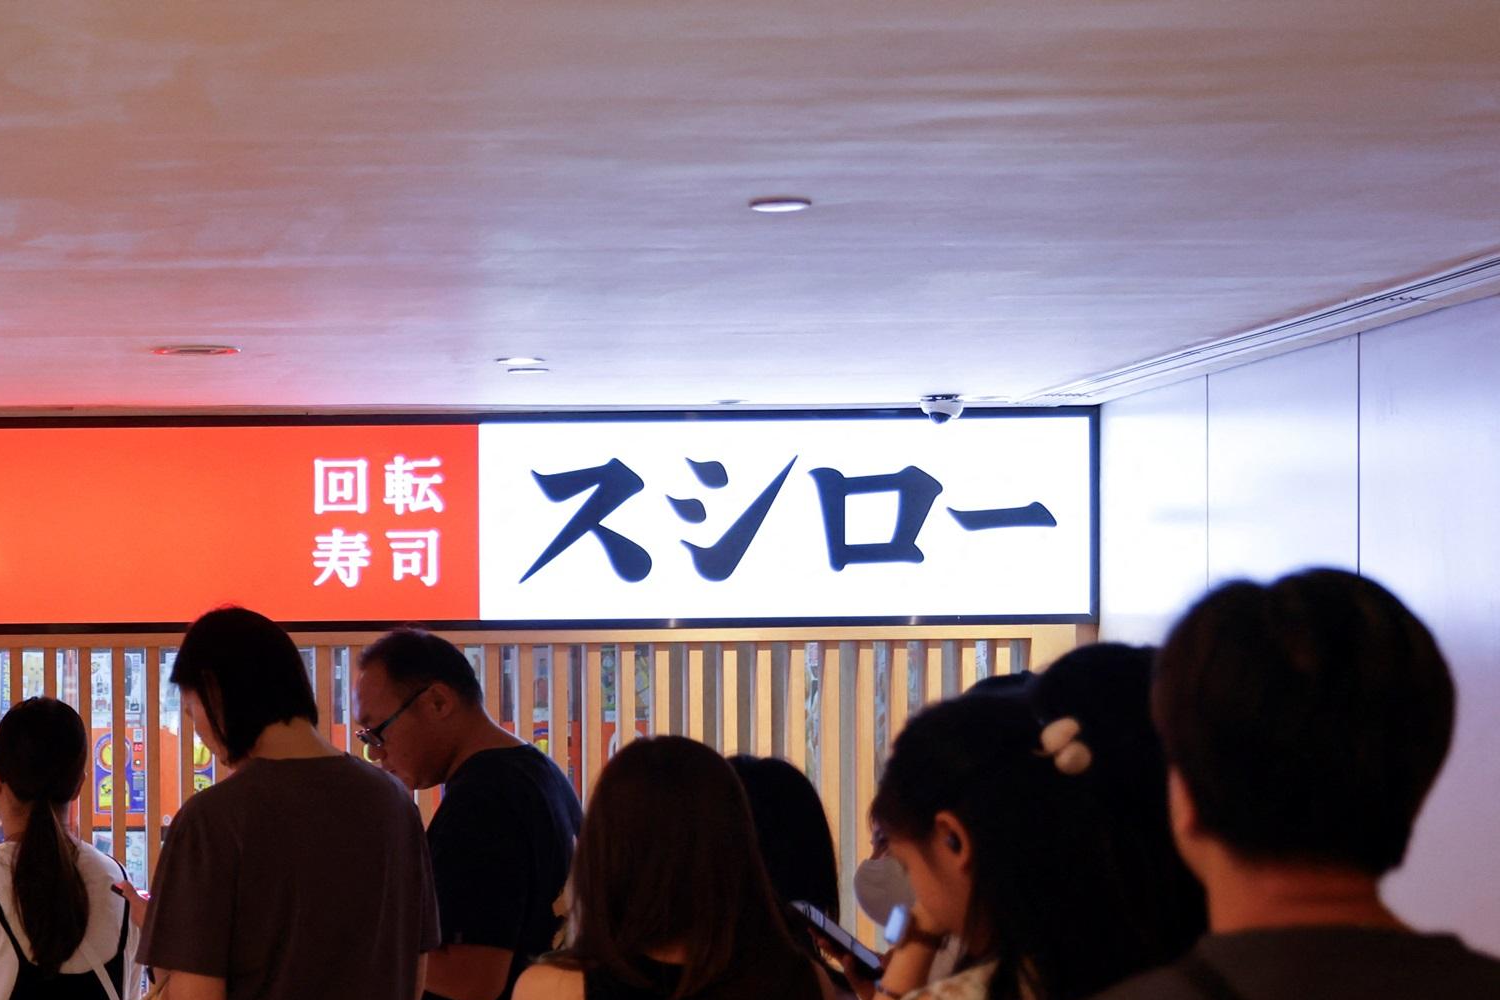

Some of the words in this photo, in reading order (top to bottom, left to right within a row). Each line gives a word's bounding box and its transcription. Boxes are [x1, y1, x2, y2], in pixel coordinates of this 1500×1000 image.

[312, 455, 445, 516] 回転
[518, 454, 1059, 584] スシロー
[311, 528, 440, 588] 寿司
